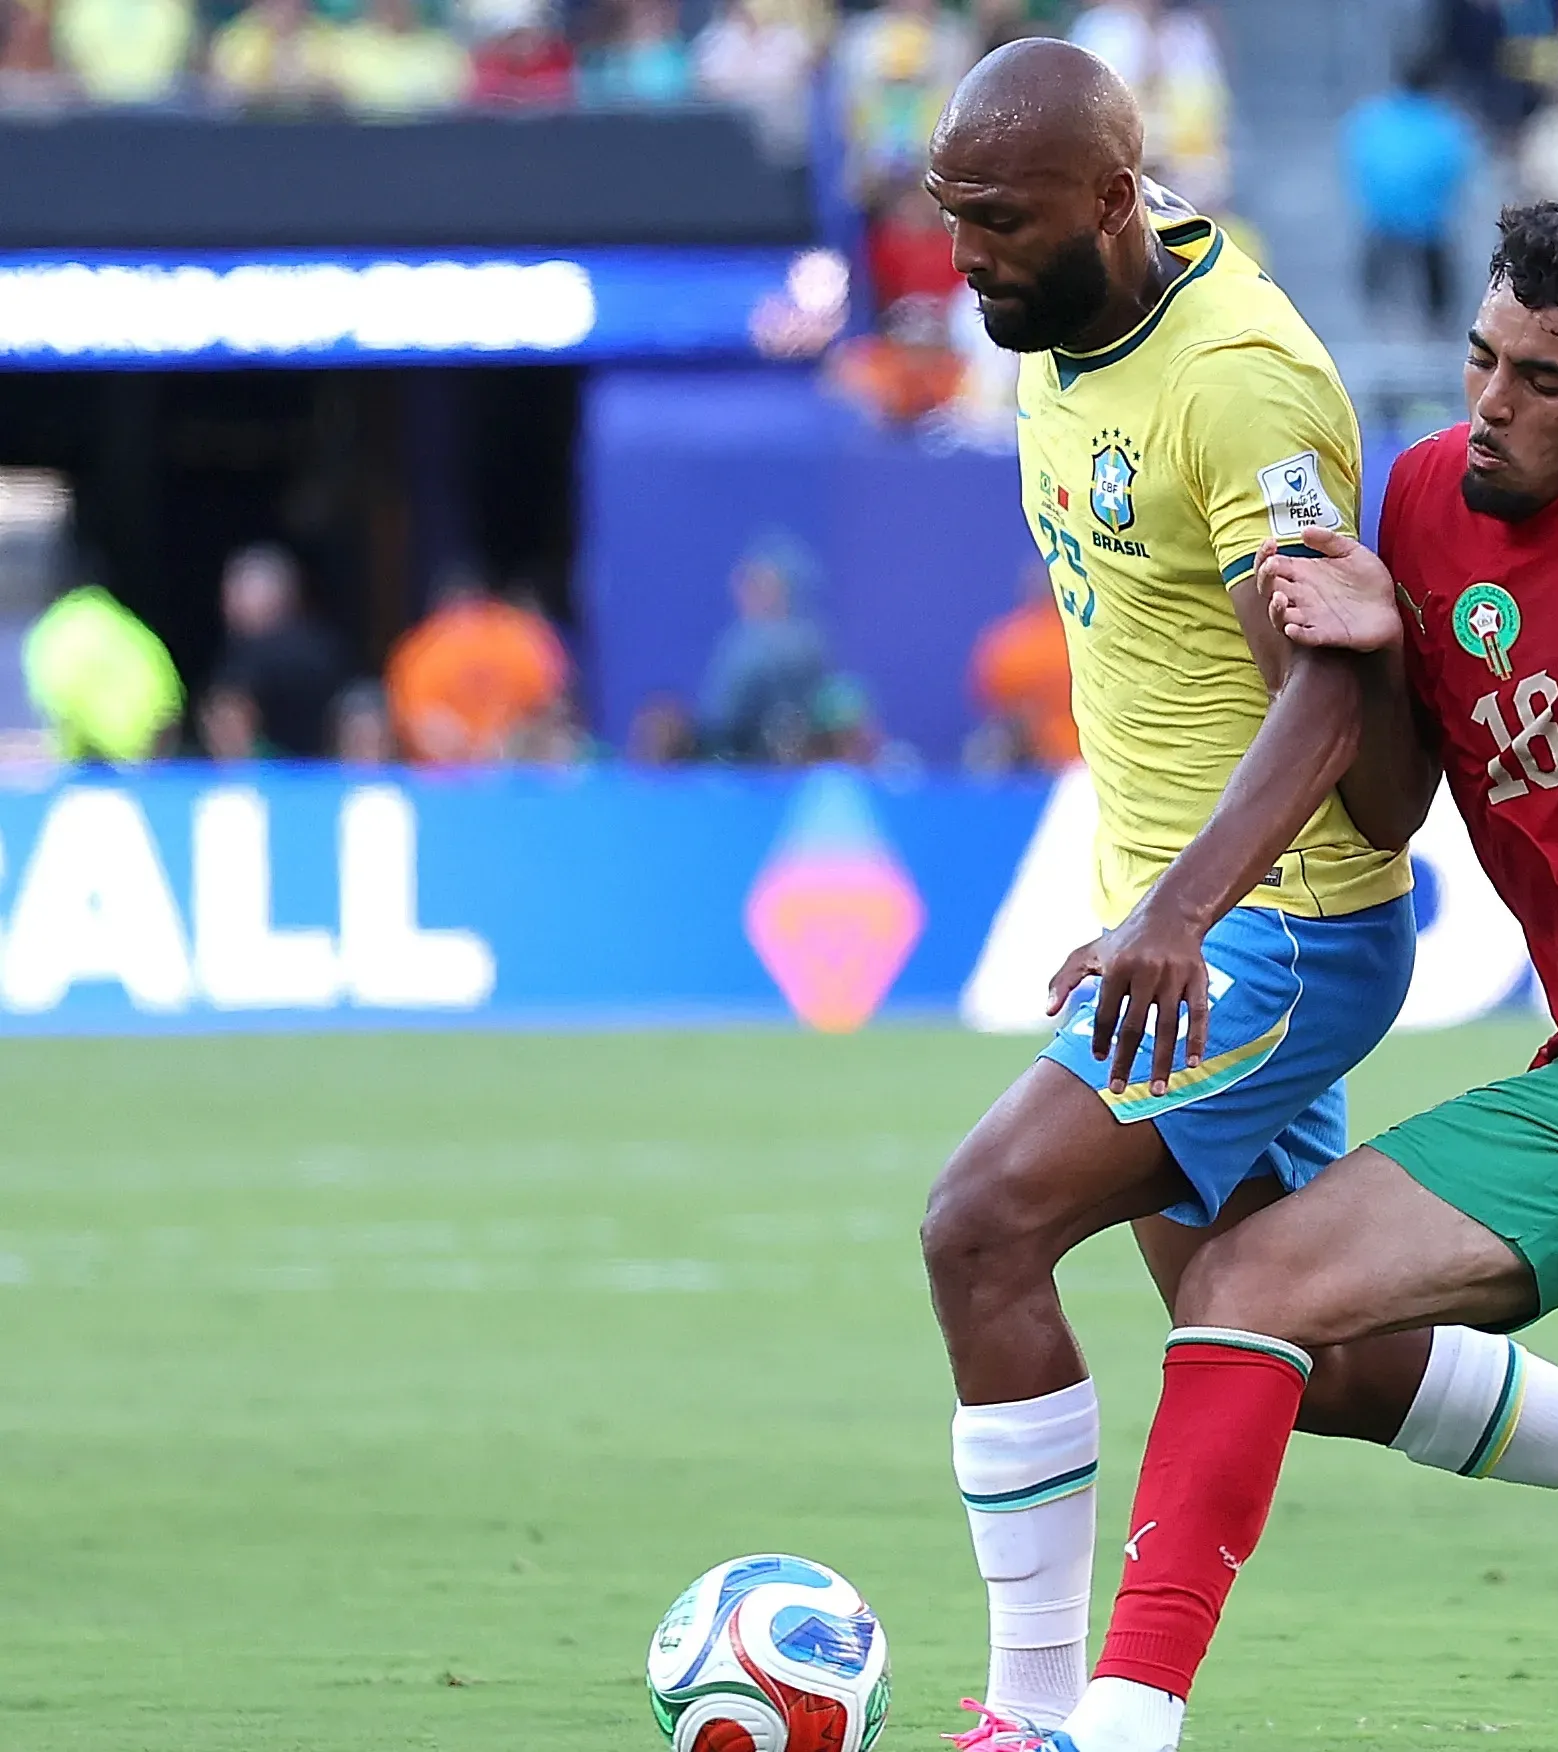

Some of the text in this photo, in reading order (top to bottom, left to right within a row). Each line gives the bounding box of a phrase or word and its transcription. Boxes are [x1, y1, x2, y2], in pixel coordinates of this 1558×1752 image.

[1102, 481, 1118, 494] CBF
[1289, 503, 1323, 519] PEACE
[1092, 530, 1151, 559] BRASIL
[0, 785, 496, 1011] ALL
